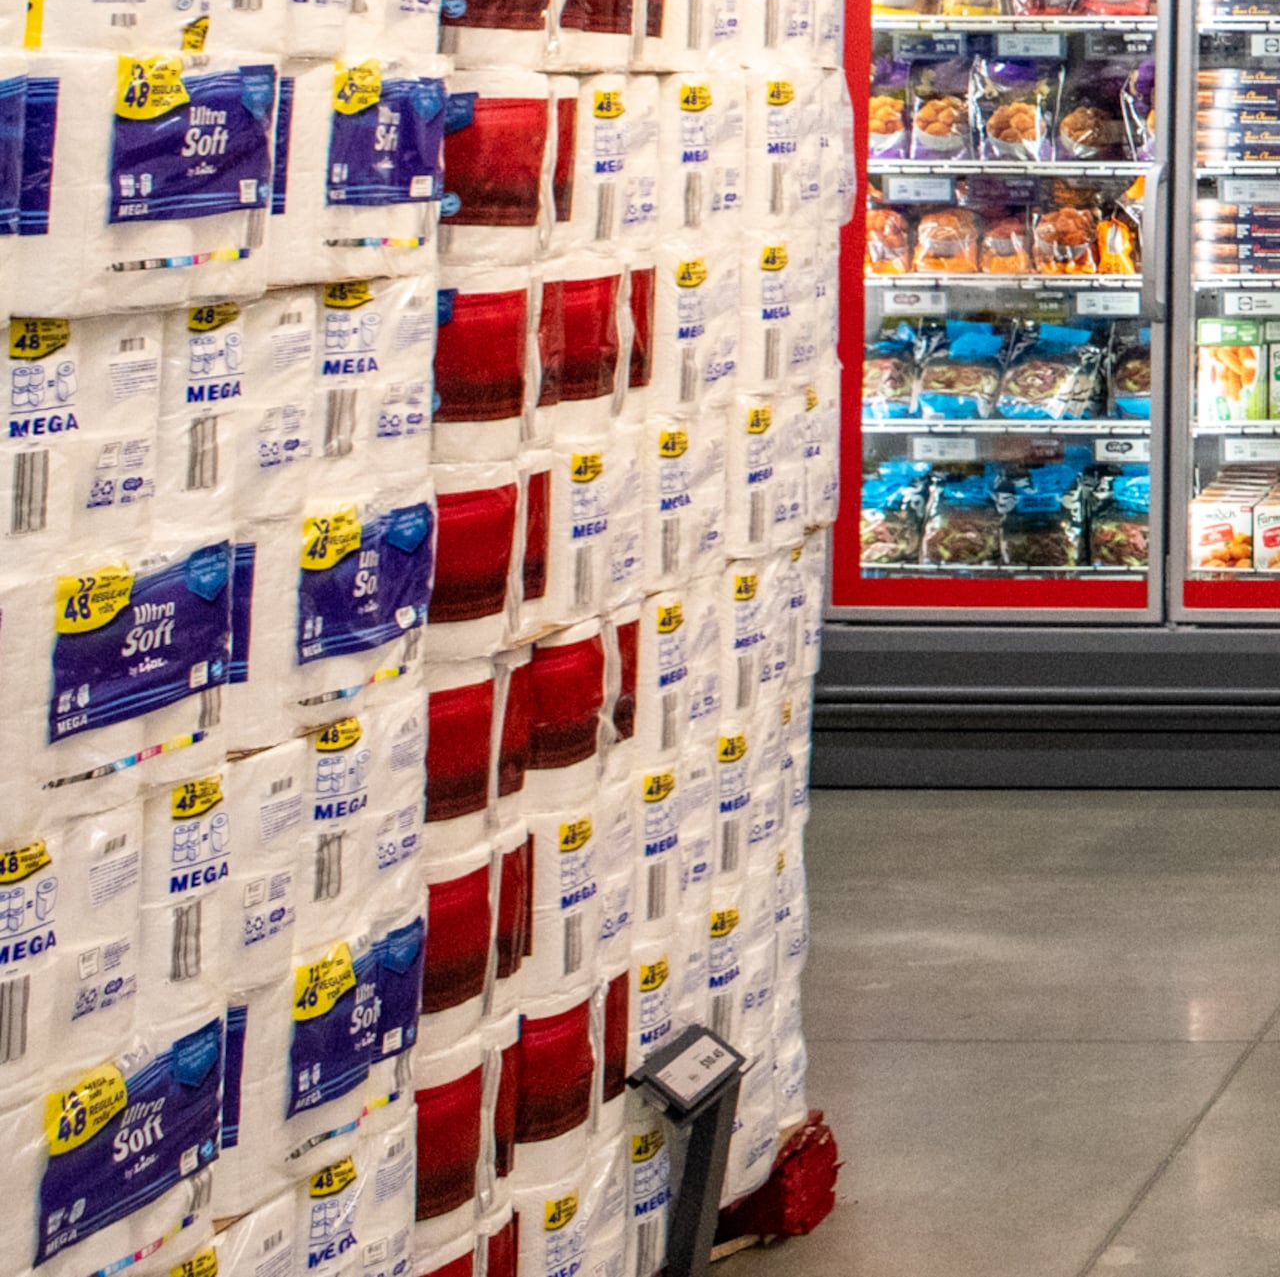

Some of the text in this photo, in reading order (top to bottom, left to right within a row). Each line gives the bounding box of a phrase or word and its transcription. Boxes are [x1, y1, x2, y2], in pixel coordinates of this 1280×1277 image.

[123, 82, 151, 108] 48
[189, 105, 227, 126] Ultra
[181, 128, 229, 158] Soft
[118, 203, 149, 217] MEGA
[192, 308, 215, 324] 48
[14, 332, 41, 351] 48
[322, 355, 380, 376] MEGA
[187, 380, 243, 404] MEGA
[9, 412, 79, 438] MEGA
[572, 519, 608, 539] MEGA
[64, 593, 92, 622] 48
[134, 601, 175, 624] Ultra
[120, 621, 175, 657] Soft
[56, 713, 89, 734] MEGA
[320, 728, 341, 744] 48
[314, 795, 368, 821] MEGA
[719, 793, 751, 813] MEGA
[645, 835, 679, 857] MEGA
[169, 862, 229, 893] MEGA
[560, 883, 598, 909] MEGA
[0, 930, 58, 963] MEGA
[709, 965, 741, 989] MEGA
[58, 1091, 126, 1143] 48 REGULAR
[120, 1096, 167, 1126] Ultra
[111, 1114, 166, 1164] Soft
[312, 1171, 335, 1191] 48
[634, 1188, 673, 1217] MEGA
[44, 1227, 79, 1257] MEGA
